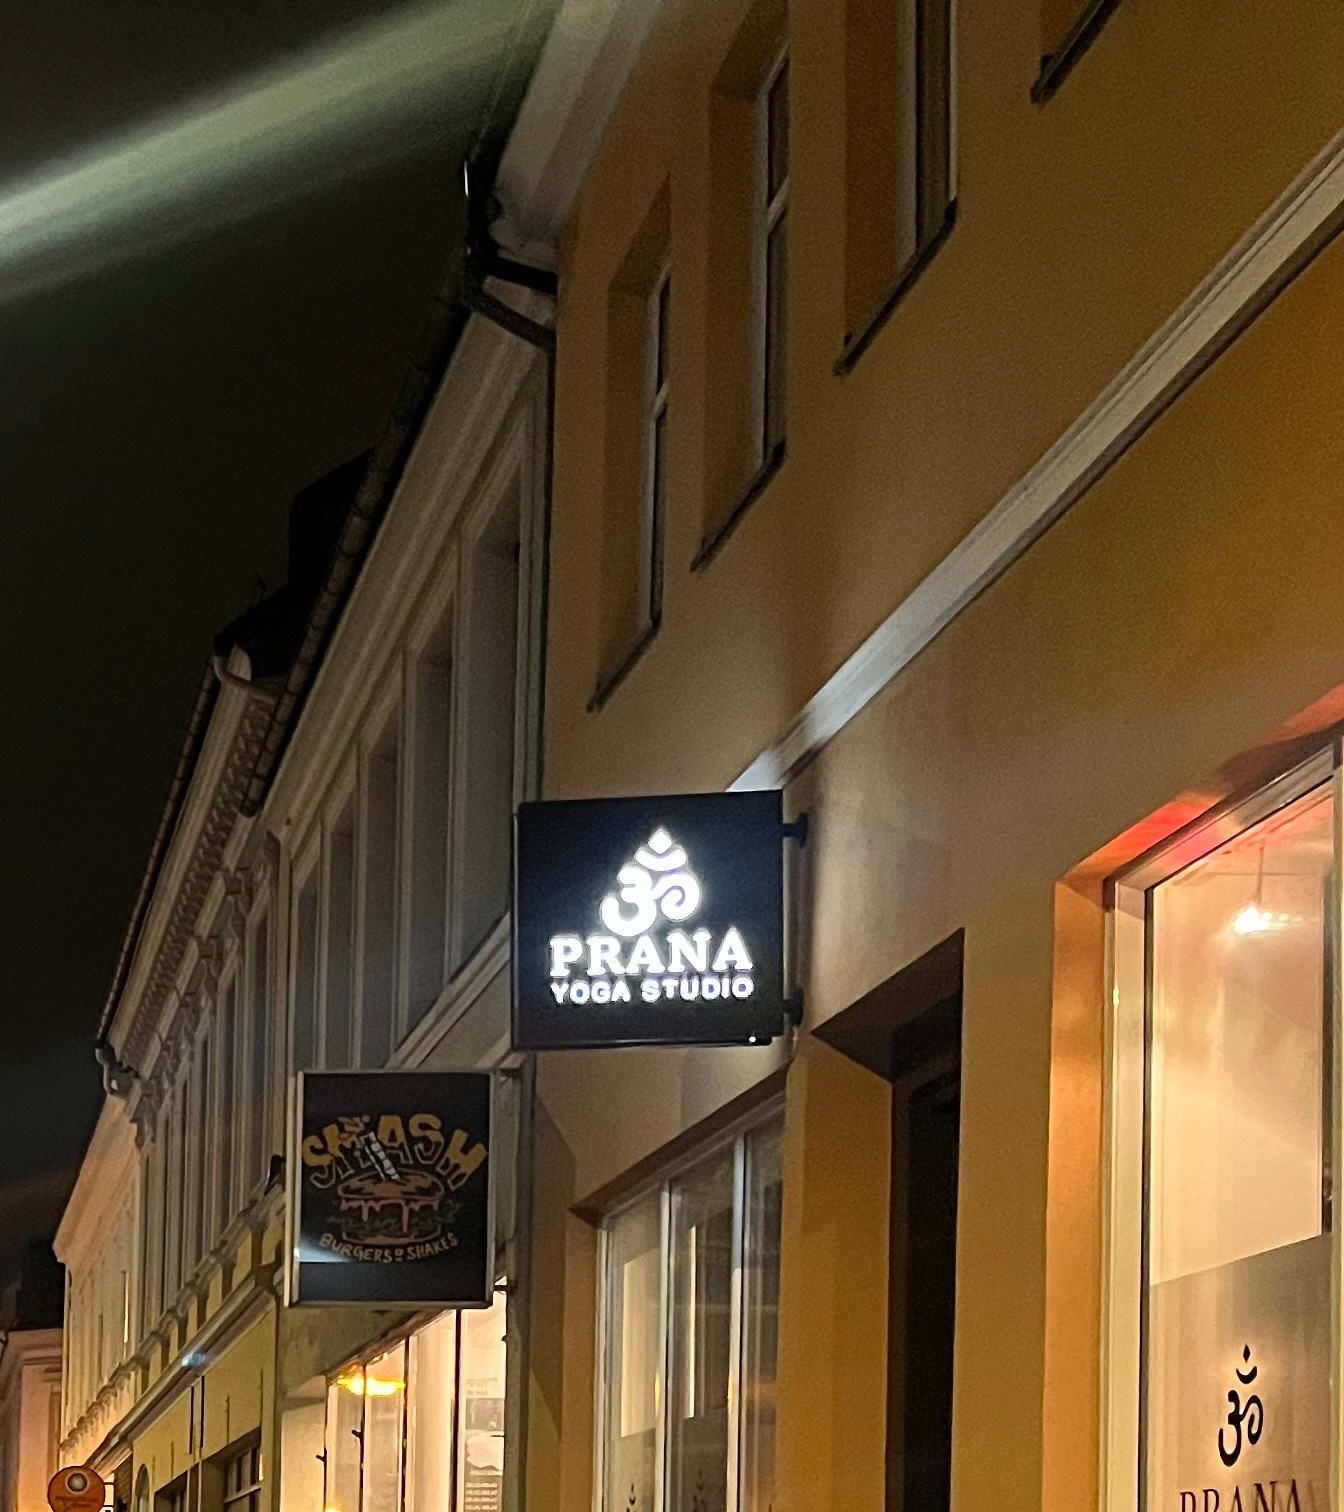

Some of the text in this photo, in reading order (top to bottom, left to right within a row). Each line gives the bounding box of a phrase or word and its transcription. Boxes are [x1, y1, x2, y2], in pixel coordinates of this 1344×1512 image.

[549, 926, 754, 977] PRANA
[550, 972, 755, 1004] YOGA STUDIO
[319, 1232, 392, 1262] BURGERS
[406, 1232, 459, 1261] SHAKES
